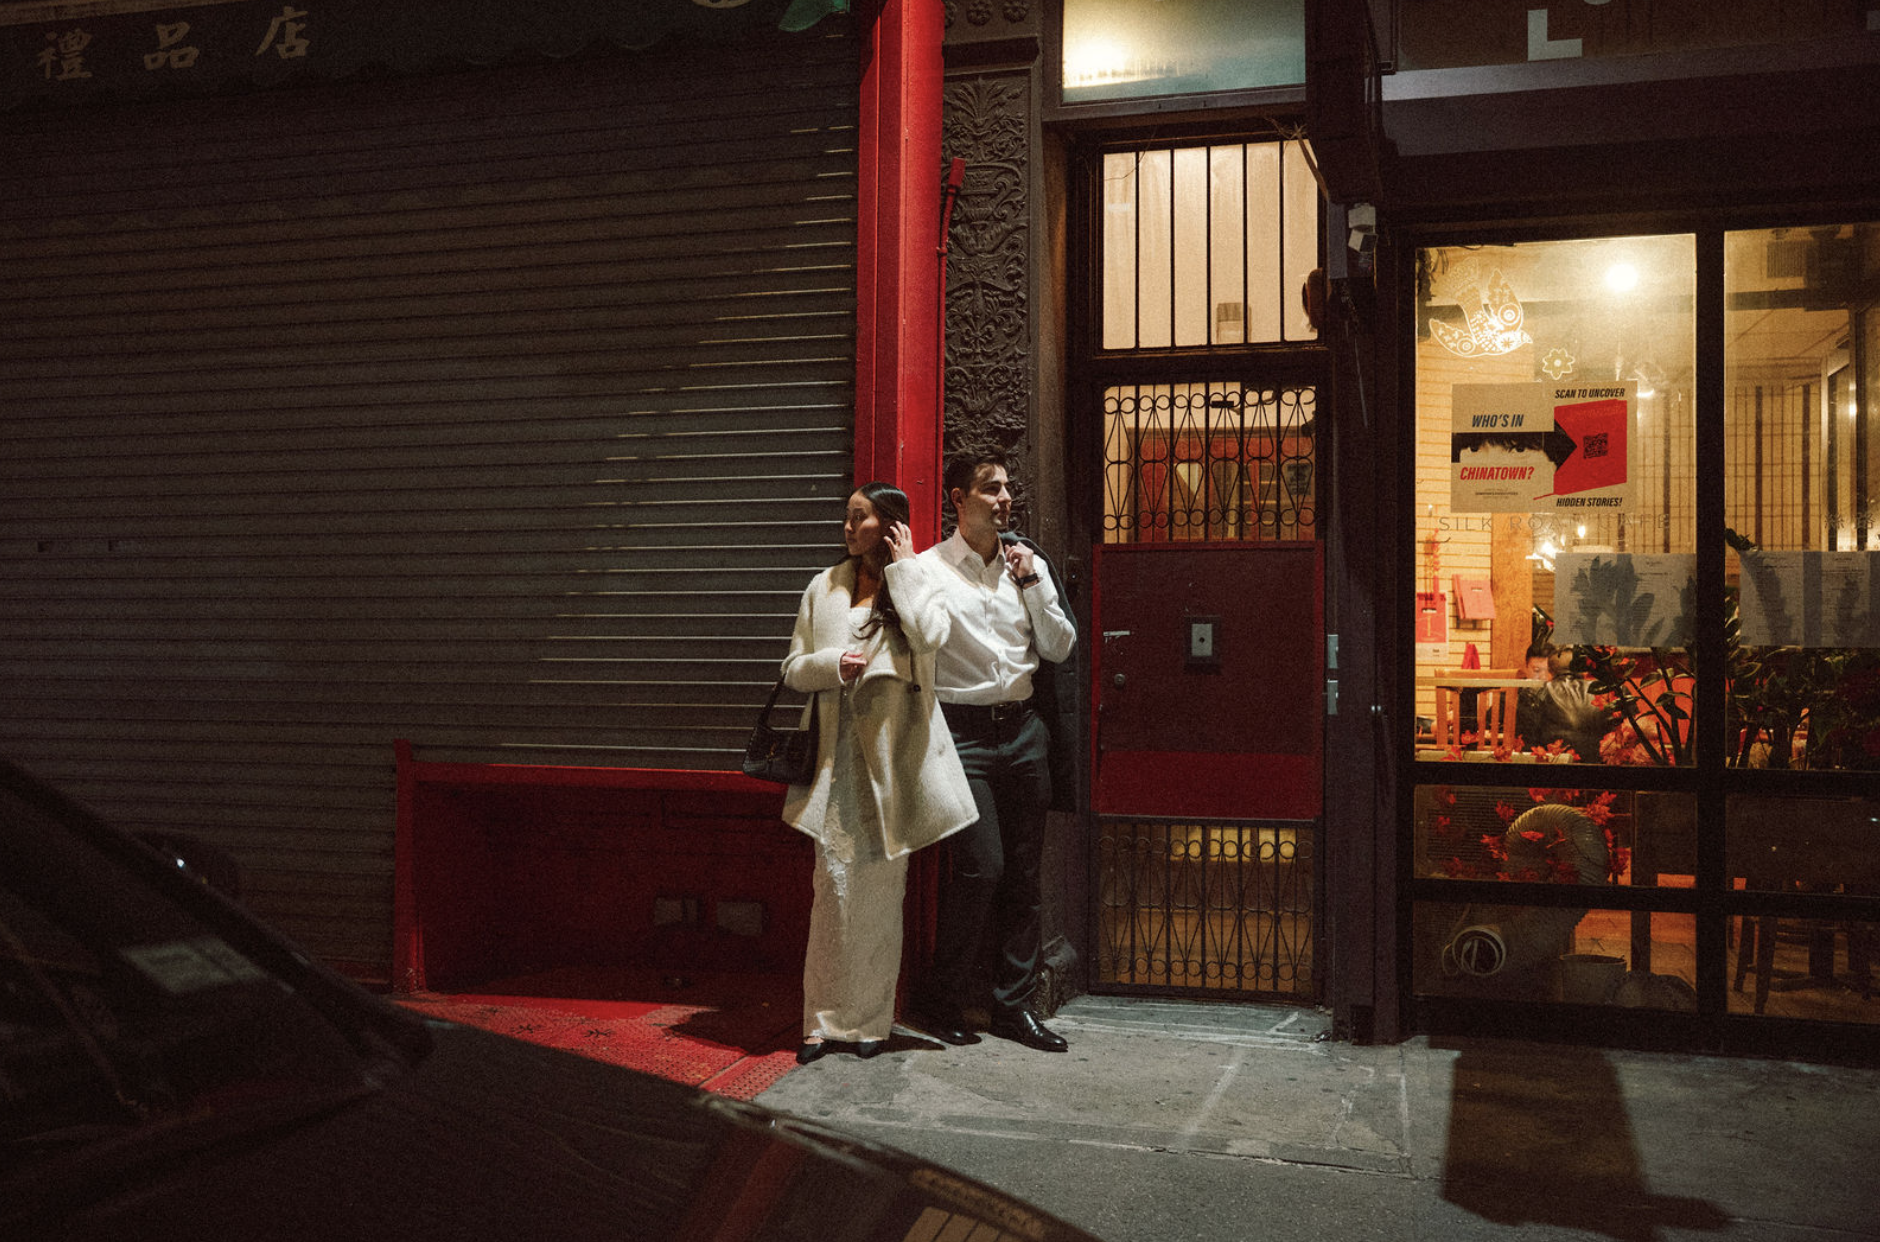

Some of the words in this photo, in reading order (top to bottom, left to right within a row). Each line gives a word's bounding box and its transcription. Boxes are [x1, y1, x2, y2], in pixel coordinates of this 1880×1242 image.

[35, 6, 311, 81] 禮品店
[1555, 389, 1576, 399] SCAN
[1577, 388, 1587, 398] TO
[1588, 387, 1625, 398] UNCOVER
[1472, 414, 1509, 428] WHO'S
[1511, 414, 1524, 427] IN
[1460, 466, 1534, 480] CHINATOWN?
[1556, 498, 1585, 507] HIDDEN
[1587, 497, 1623, 507] STORIES!
[1438, 516, 1492, 531] SILK
